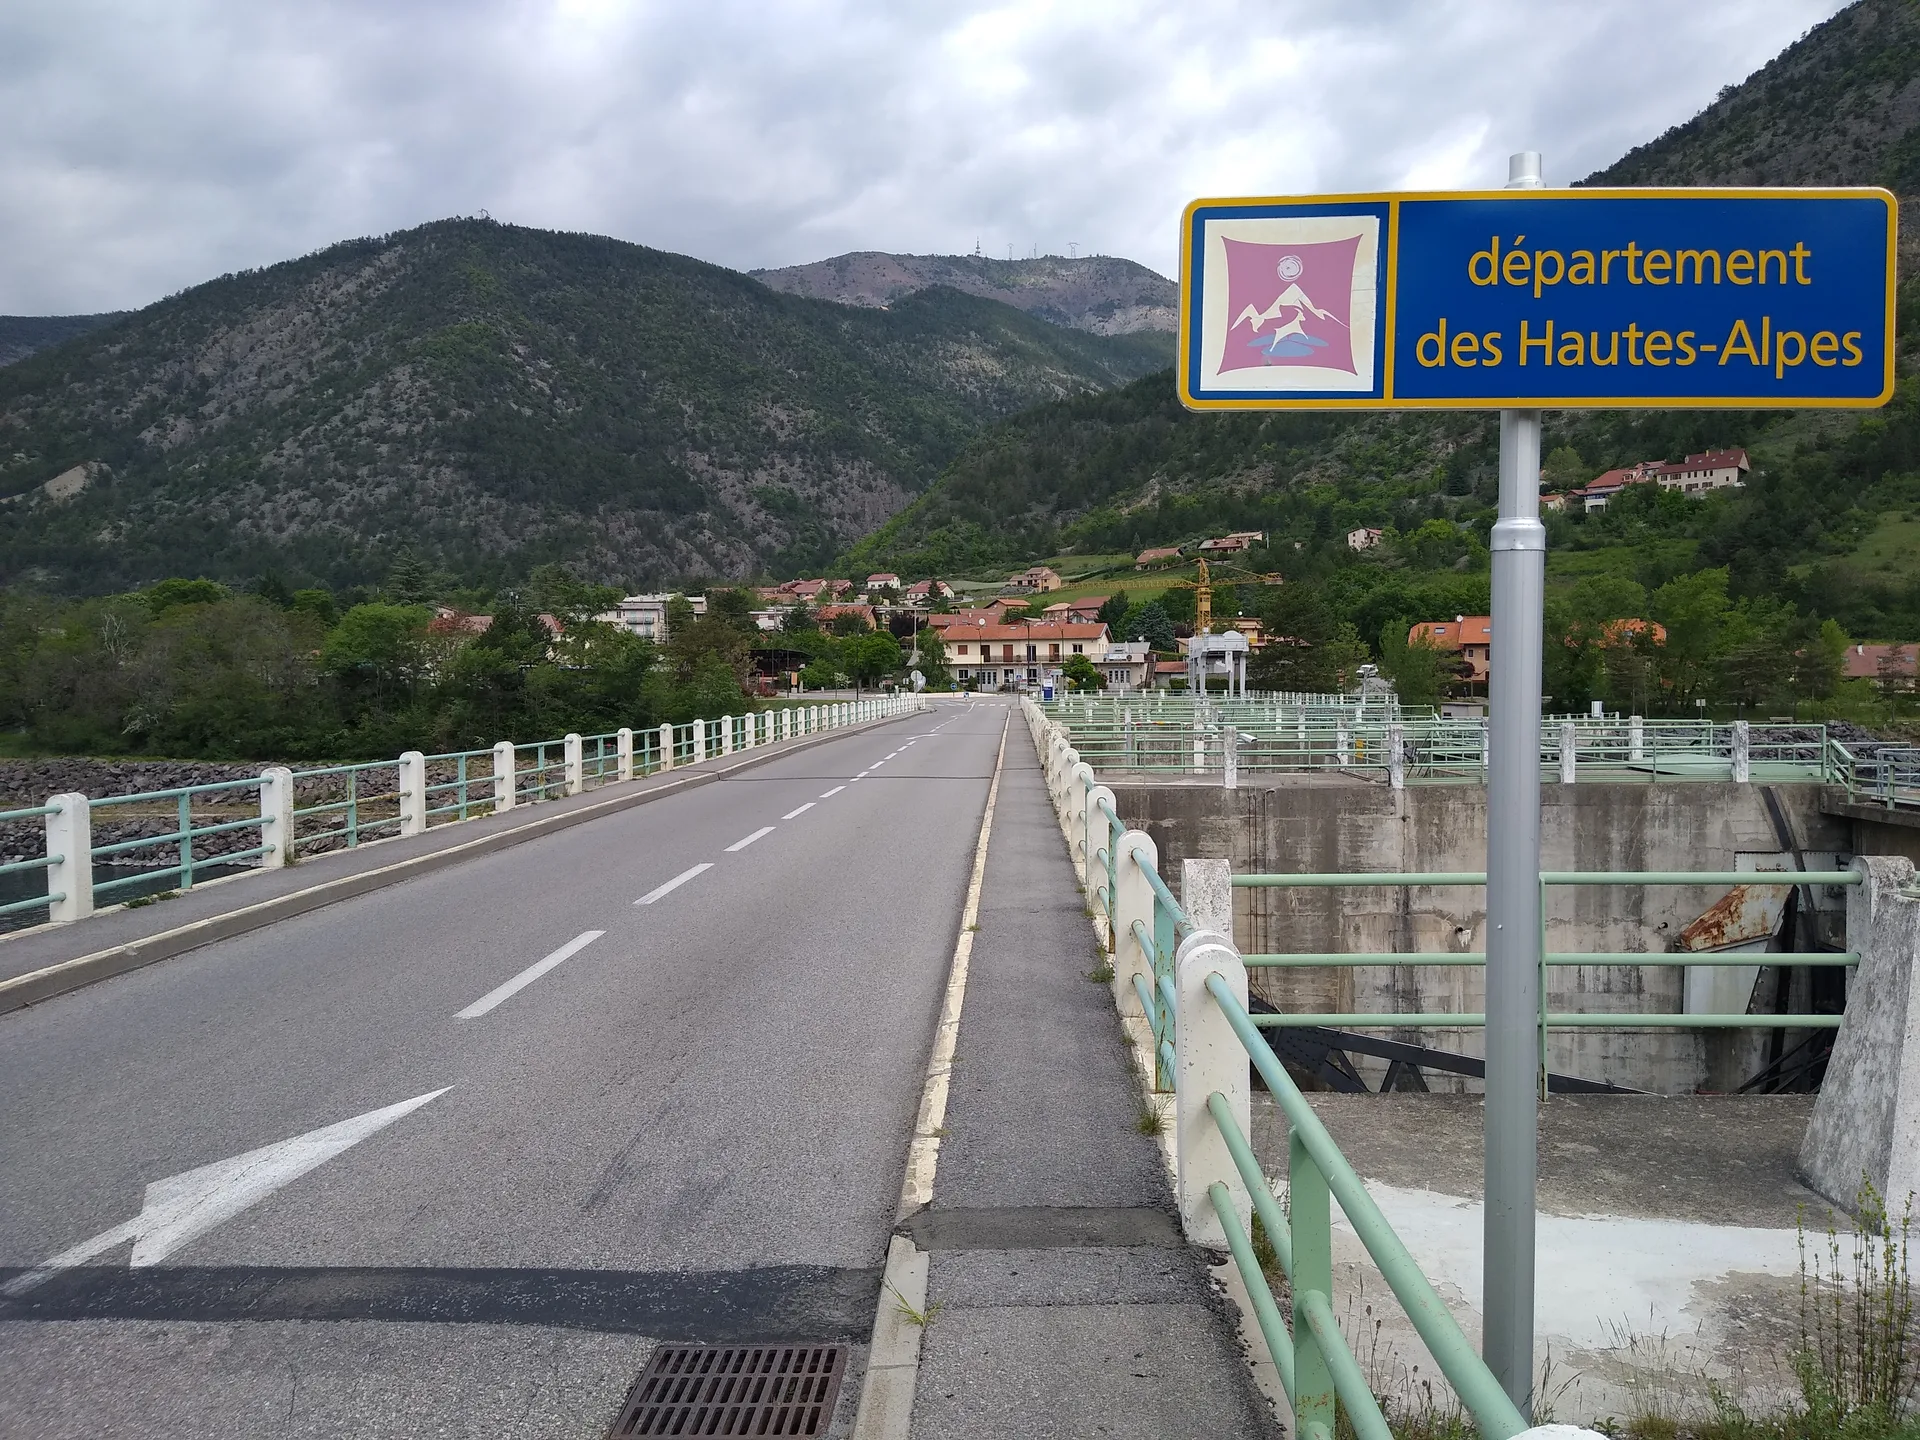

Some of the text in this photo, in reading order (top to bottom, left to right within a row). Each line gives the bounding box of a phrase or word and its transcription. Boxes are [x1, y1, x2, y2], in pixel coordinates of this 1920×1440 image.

[1467, 236, 1811, 298] département
[1415, 317, 1862, 378] des Hautes-Alpes
